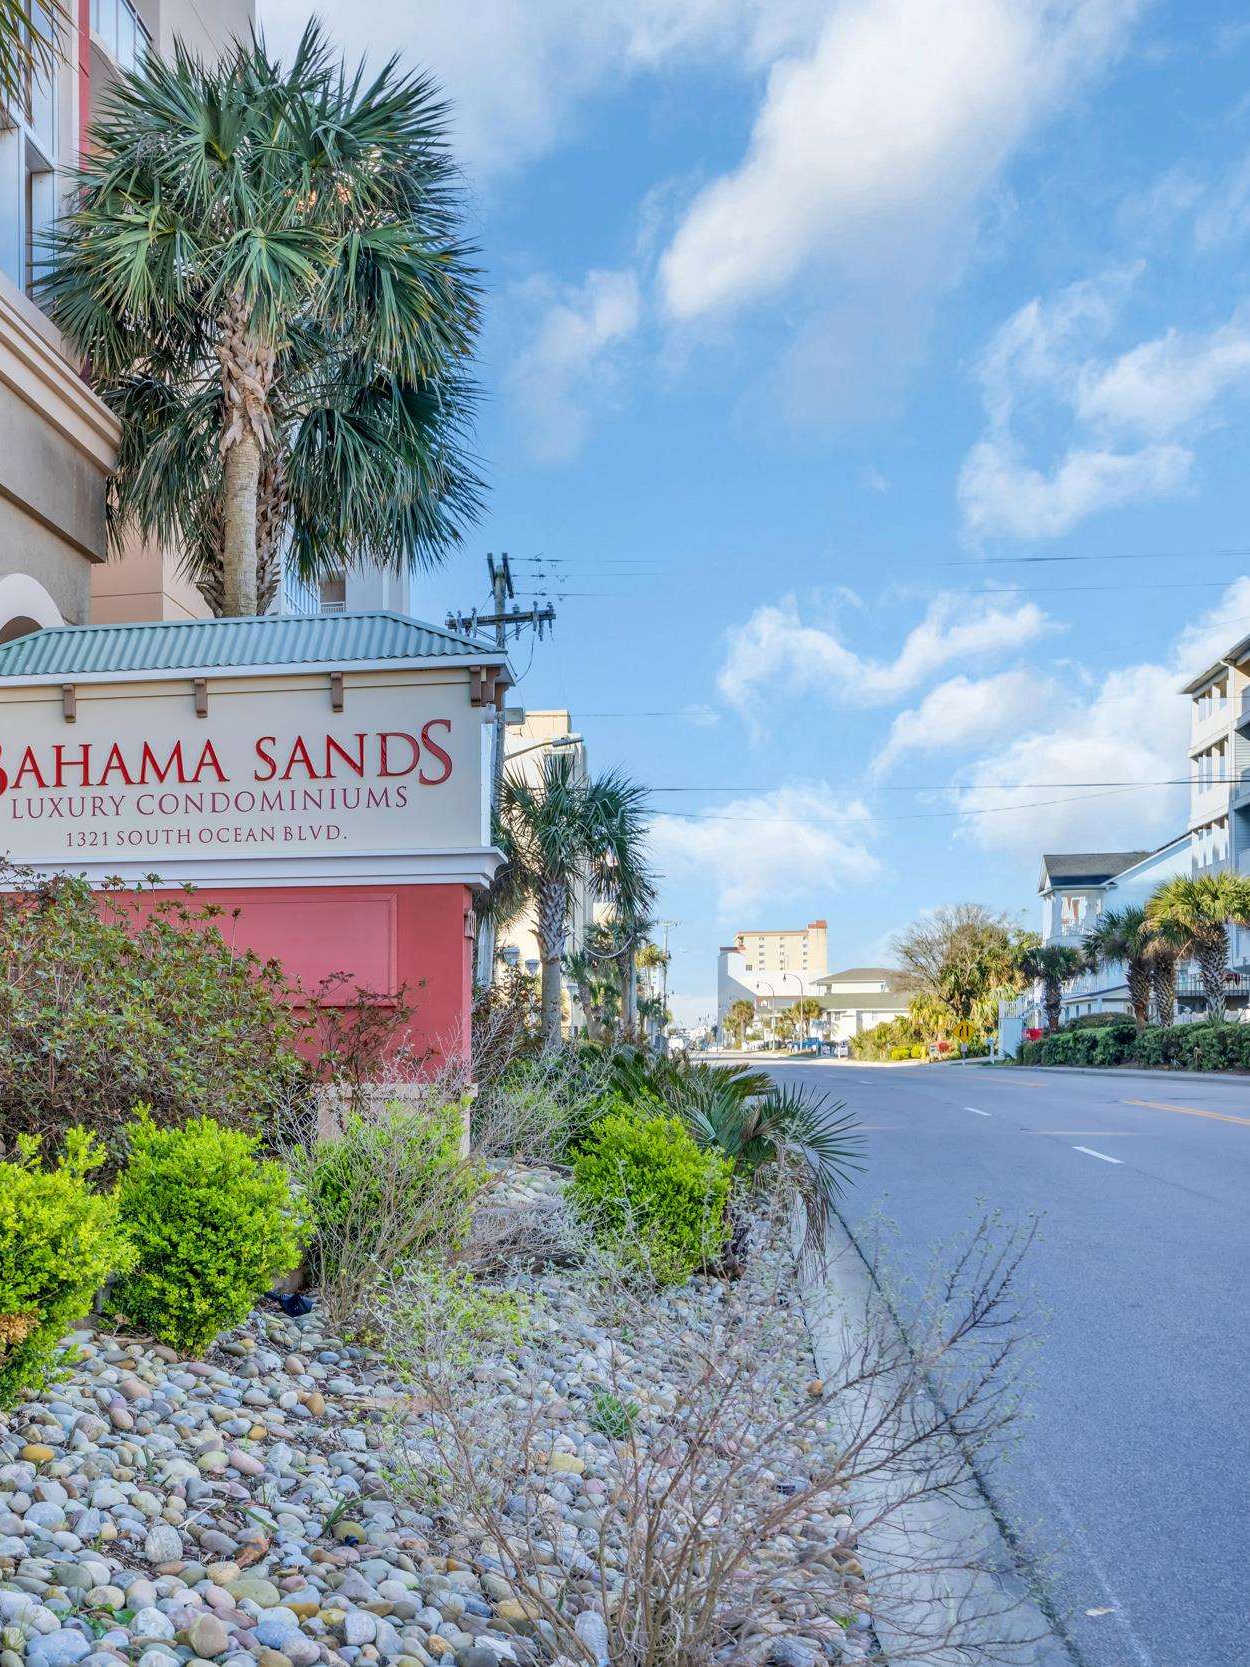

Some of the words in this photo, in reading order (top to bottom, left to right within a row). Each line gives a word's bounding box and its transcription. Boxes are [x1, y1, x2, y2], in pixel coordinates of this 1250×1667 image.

[253, 718, 453, 786] SANDS
[12, 794, 126, 819] LUXURY
[136, 786, 408, 817] CONDOMINIUMS
[66, 830, 109, 847] 1321
[116, 828, 192, 847] SOUTH
[198, 826, 276, 844] OCEAN
[283, 824, 348, 841] BLVD.
